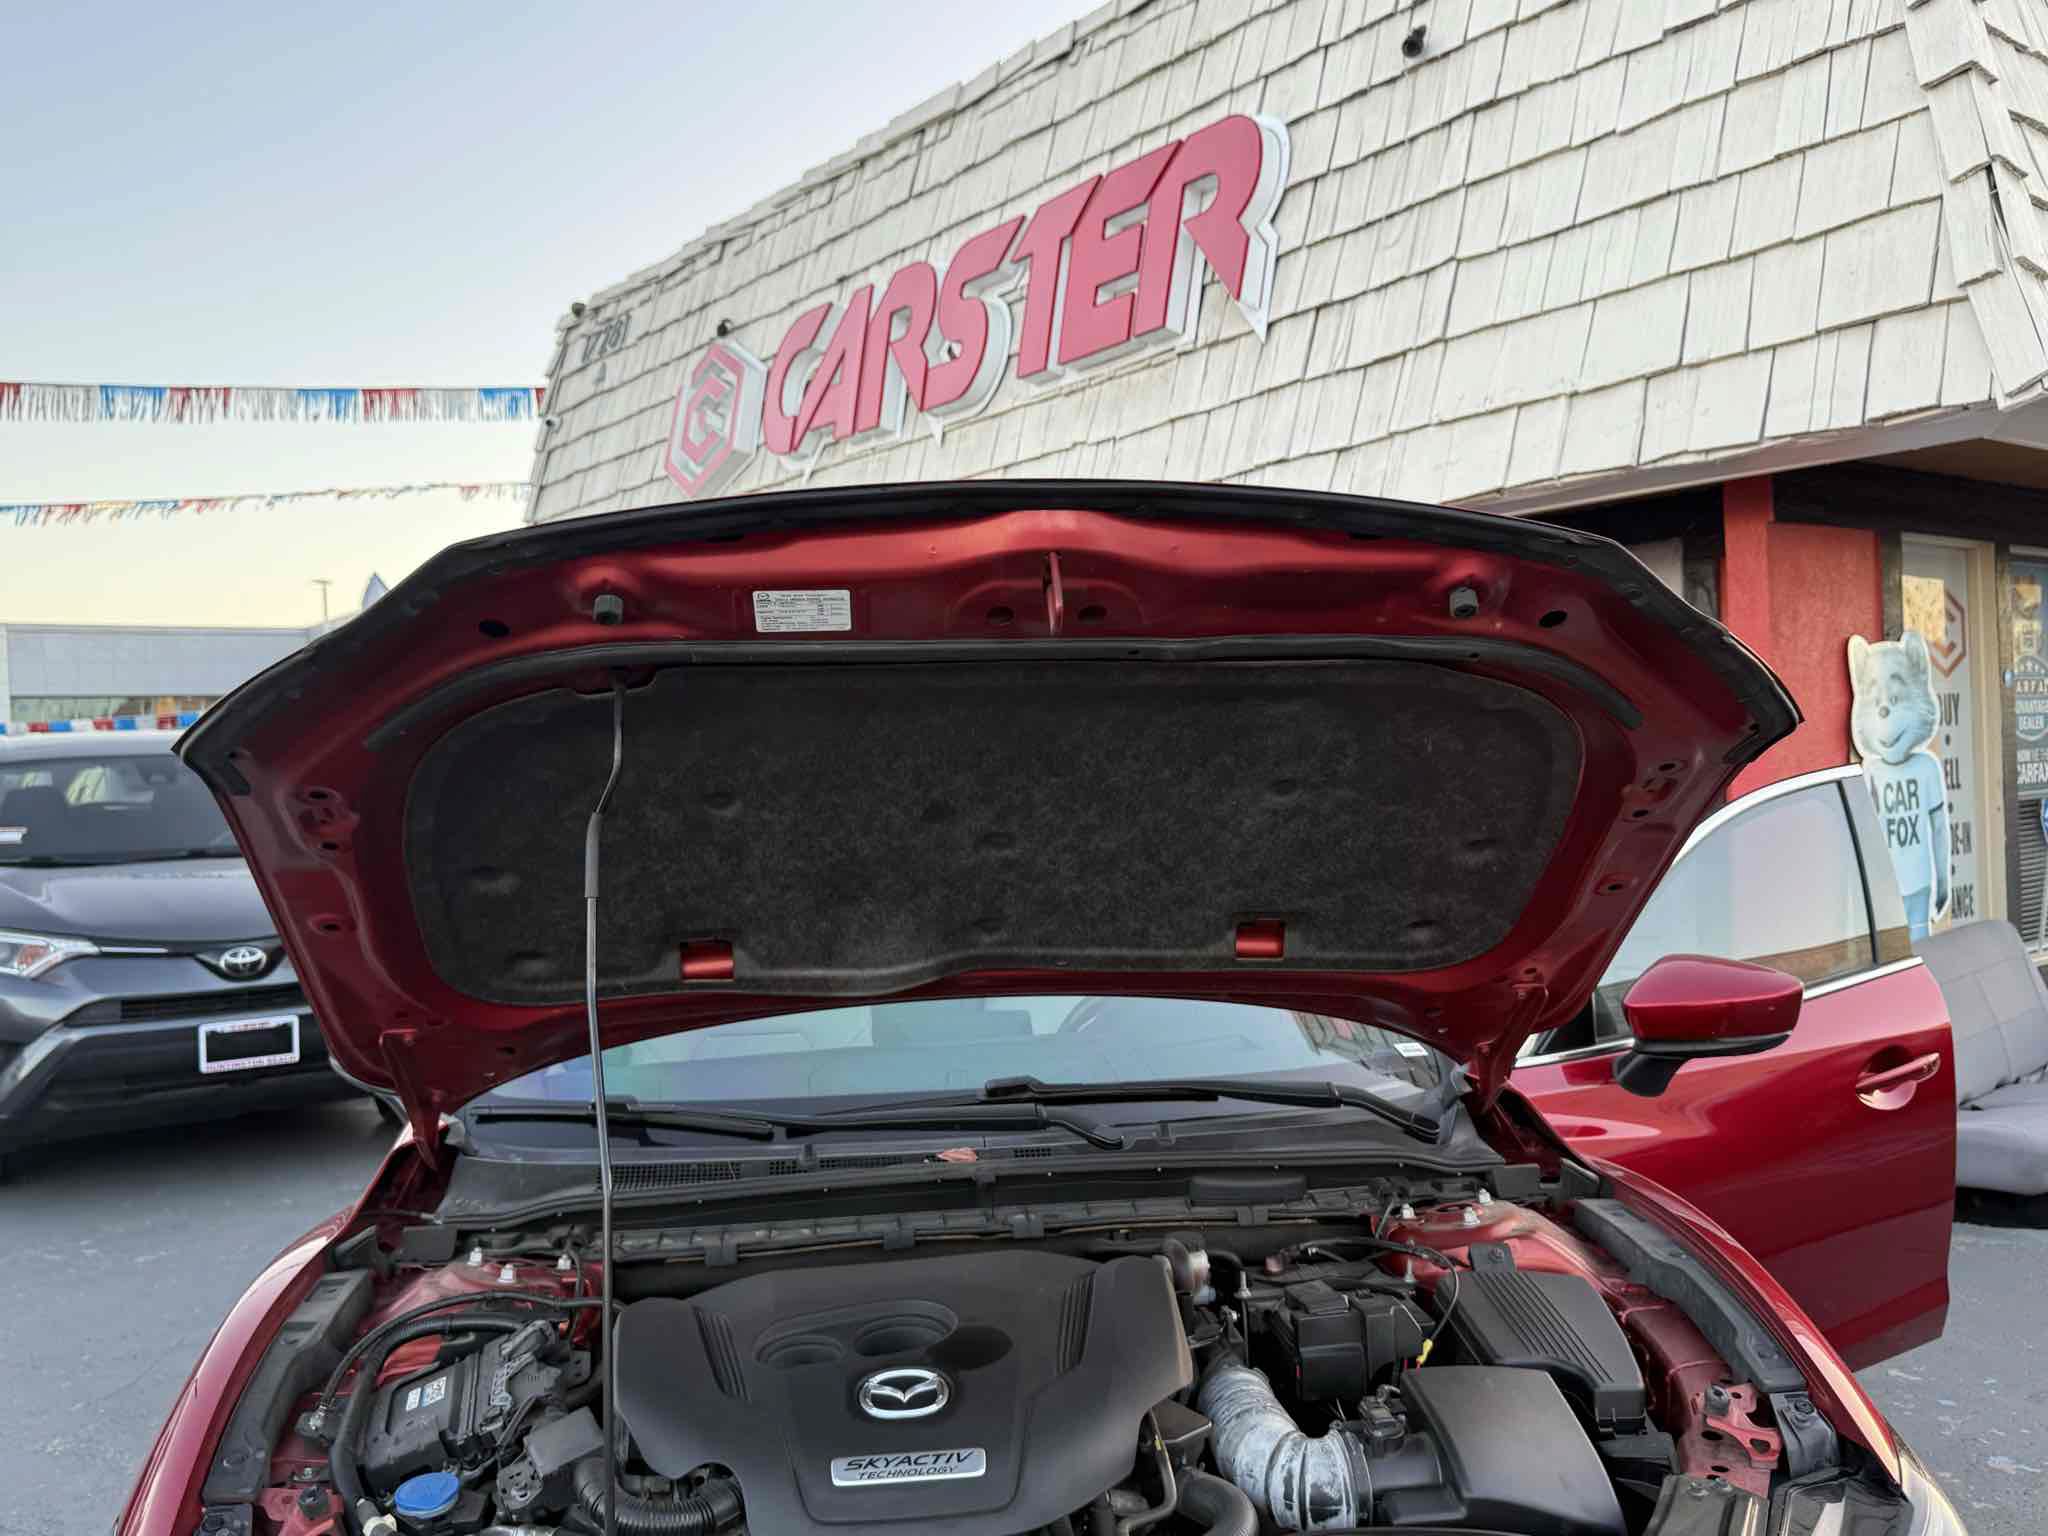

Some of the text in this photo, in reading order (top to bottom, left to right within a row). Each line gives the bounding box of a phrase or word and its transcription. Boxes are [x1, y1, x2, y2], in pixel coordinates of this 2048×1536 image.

[763, 114, 1275, 456] CARSTER
[1943, 758, 1961, 790] ELL
[1883, 778, 1920, 814] CAR
[1886, 814, 1921, 848] FOX
[844, 1452, 974, 1472] SKYACTIV
[857, 1465, 958, 1480] TECHNOLOGY
